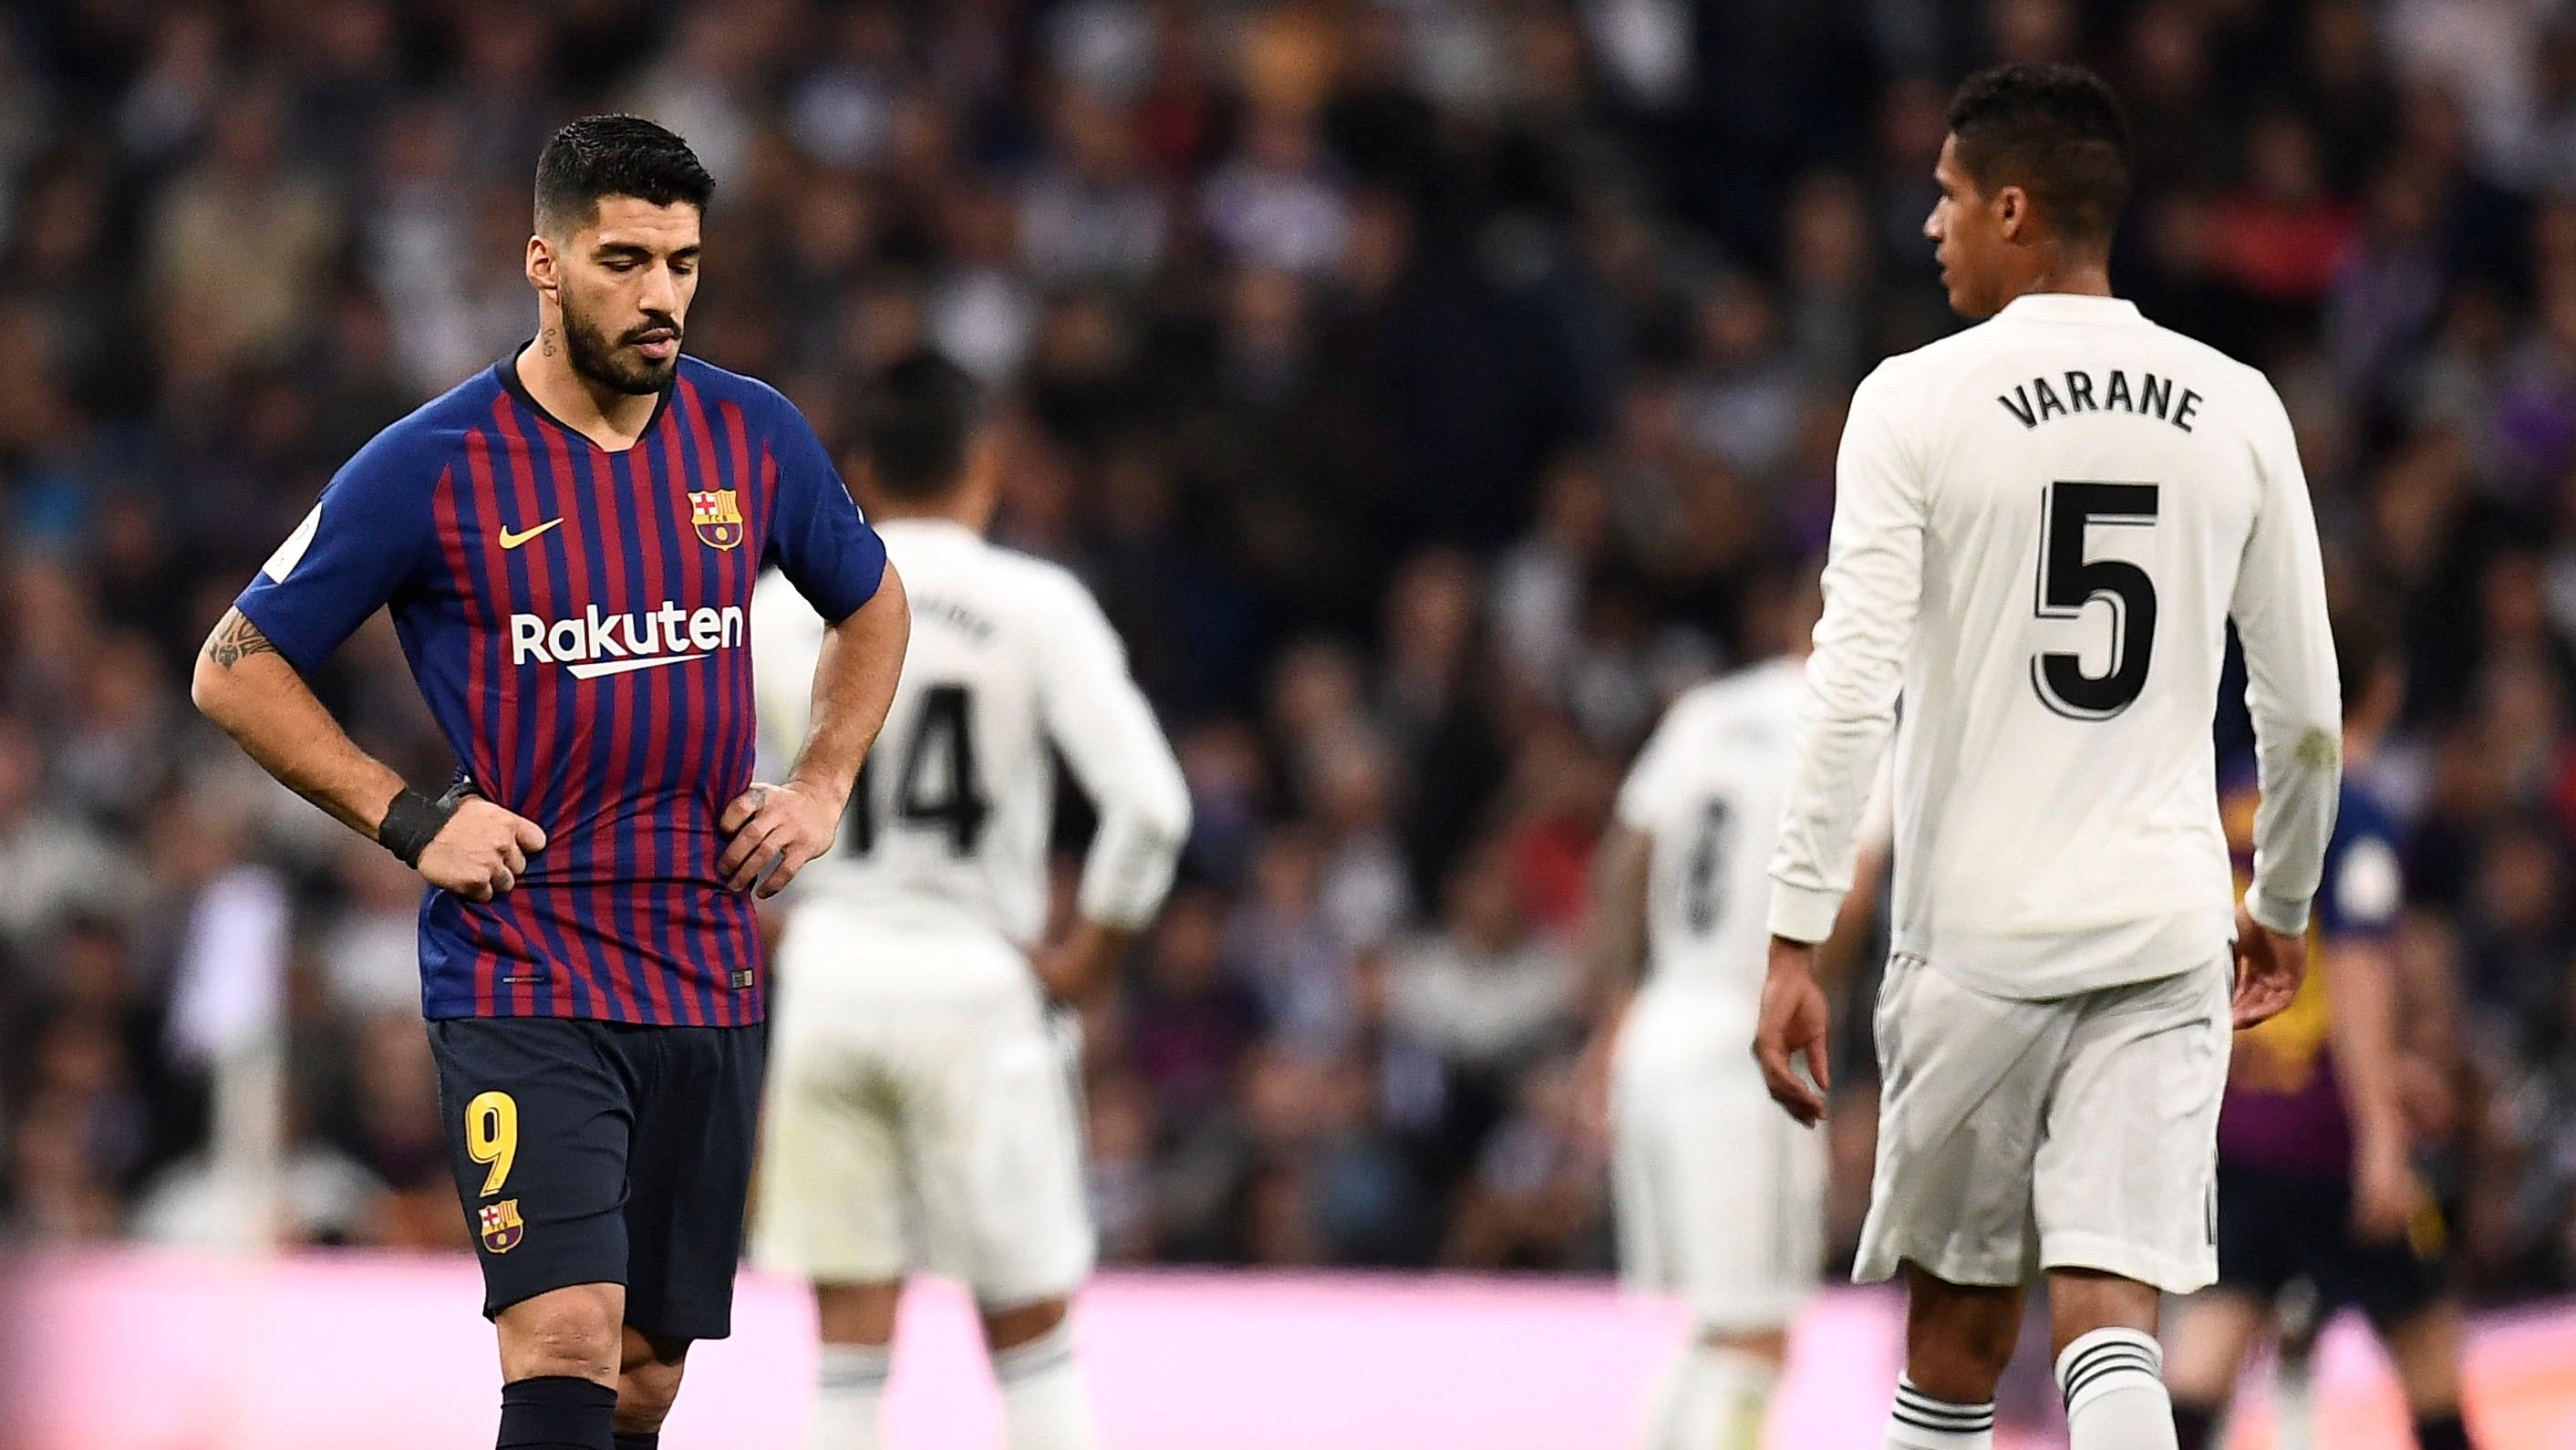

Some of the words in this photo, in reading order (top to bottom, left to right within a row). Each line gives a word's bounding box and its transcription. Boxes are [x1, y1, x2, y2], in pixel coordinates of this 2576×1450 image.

[1997, 370, 2203, 433] VARANE
[511, 600, 743, 665] Rakuten
[2031, 480, 2159, 721] 5
[465, 1091, 518, 1197] 9
